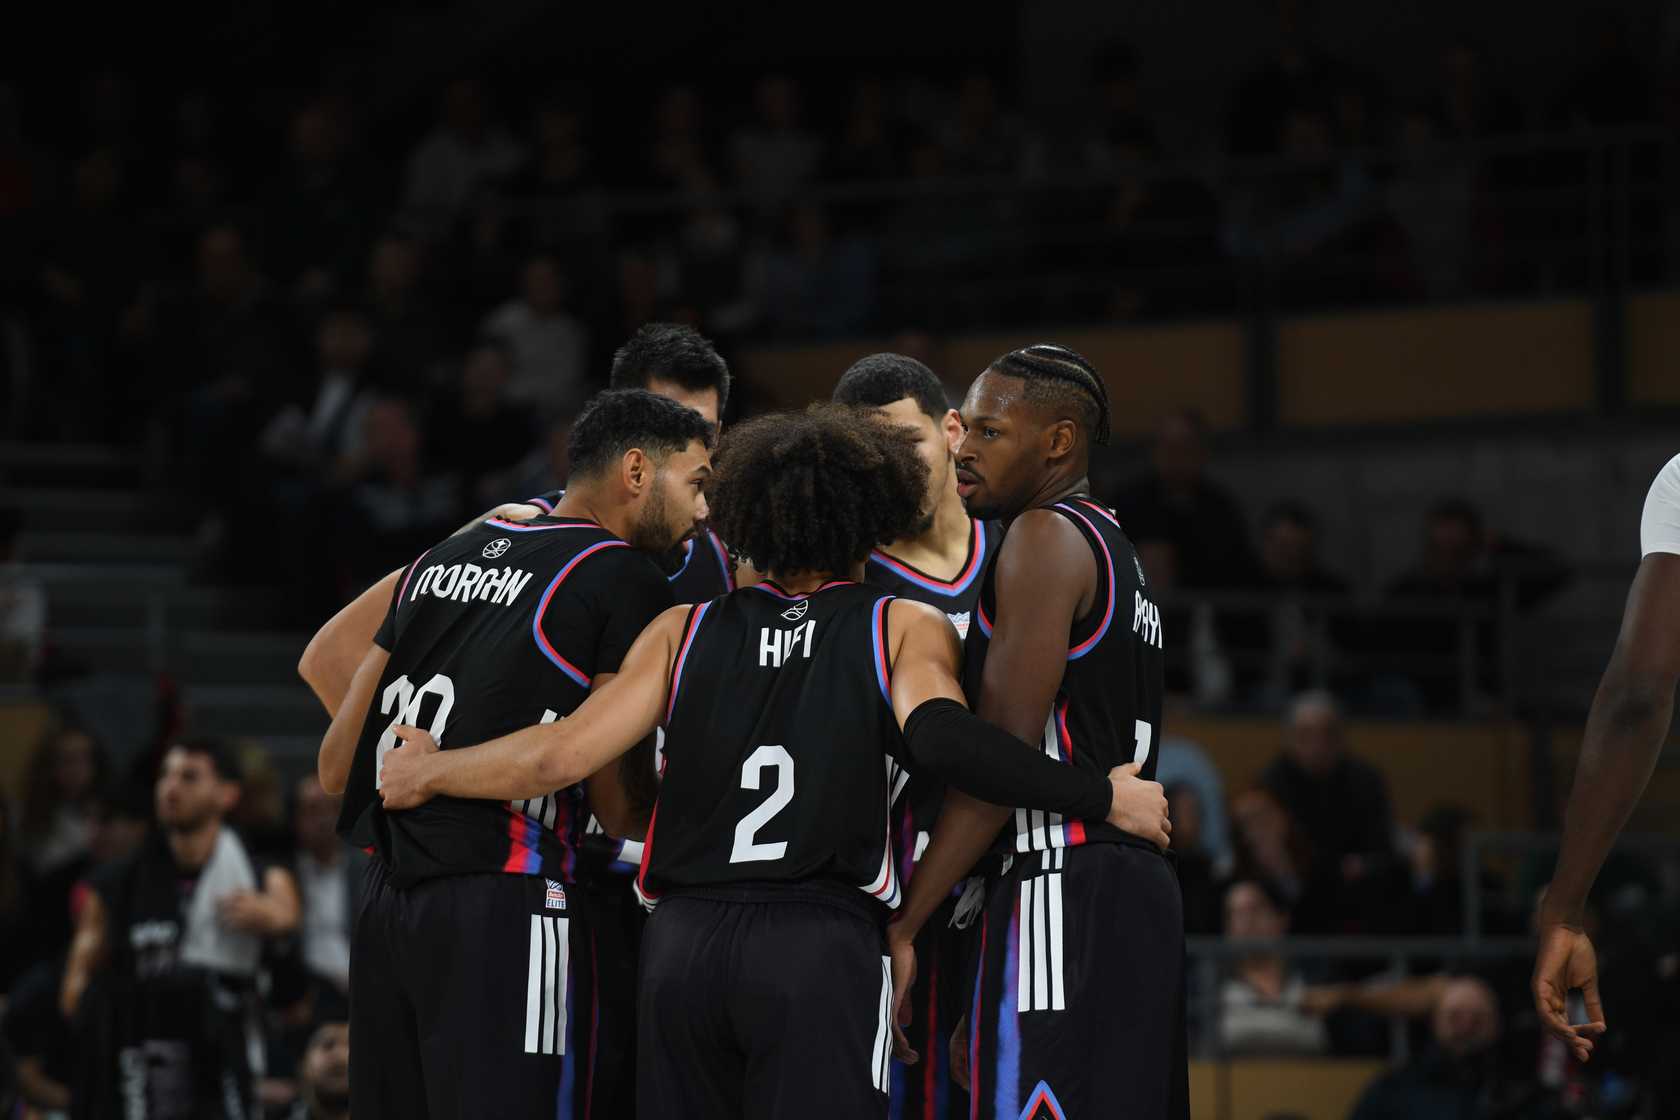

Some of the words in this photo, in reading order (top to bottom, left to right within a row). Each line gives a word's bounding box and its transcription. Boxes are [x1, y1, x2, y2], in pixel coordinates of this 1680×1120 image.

[759, 619, 817, 668] HIFI
[375, 673, 456, 790] 20
[729, 745, 795, 864] 2
